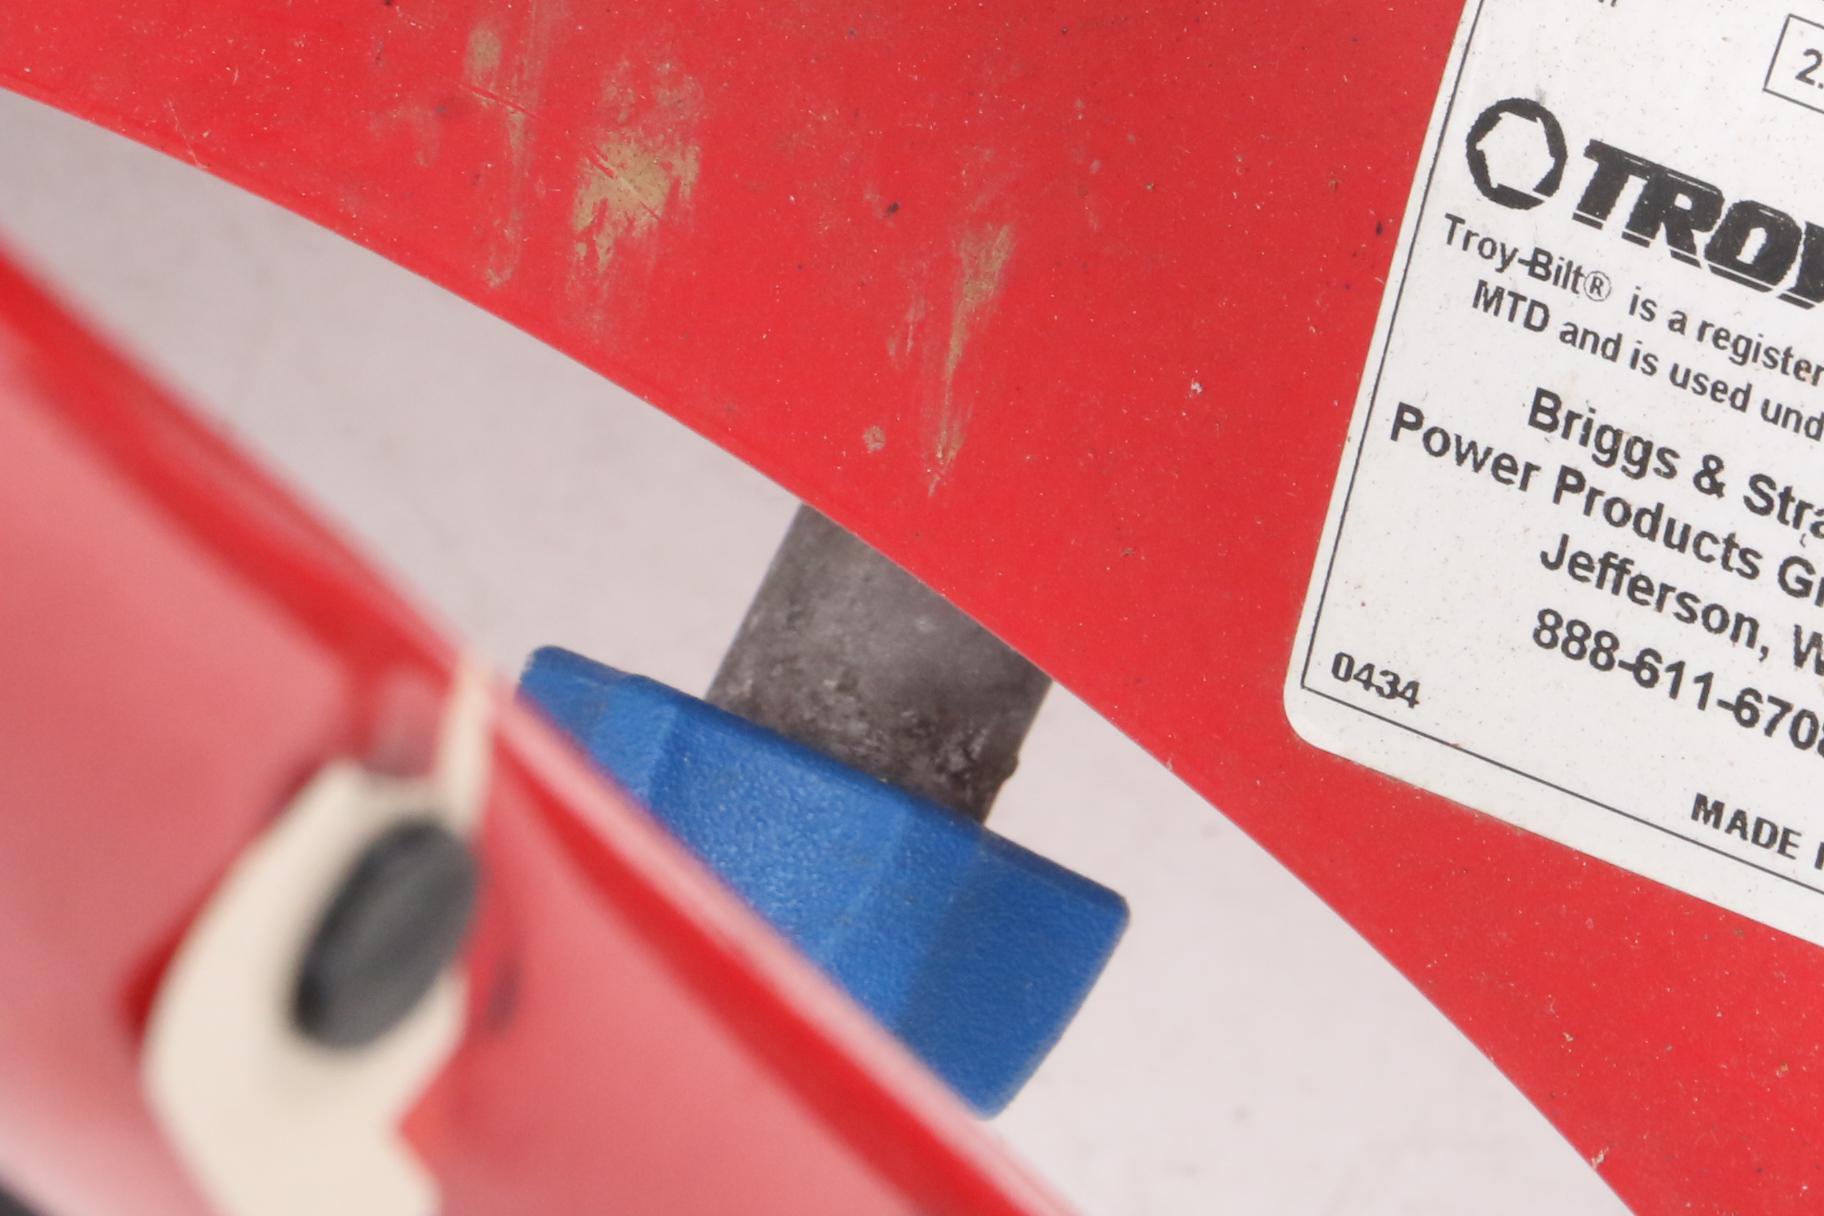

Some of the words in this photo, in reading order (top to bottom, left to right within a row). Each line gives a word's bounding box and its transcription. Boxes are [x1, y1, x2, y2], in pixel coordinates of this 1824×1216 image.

[1473, 280, 1550, 332] MTD
[1560, 322, 1622, 362] and
[1630, 341, 1658, 376] is
[1670, 363, 1752, 412] used
[1629, 286, 1656, 322] is
[1668, 311, 1687, 335] a
[1391, 402, 1541, 491] Power
[1553, 465, 1762, 580] Products
[1528, 387, 1680, 480] Briggs
[1693, 454, 1725, 498] &
[1540, 534, 1768, 662] Jefferson,
[1332, 652, 1419, 708] 0434
[1691, 793, 1801, 859] MADE
